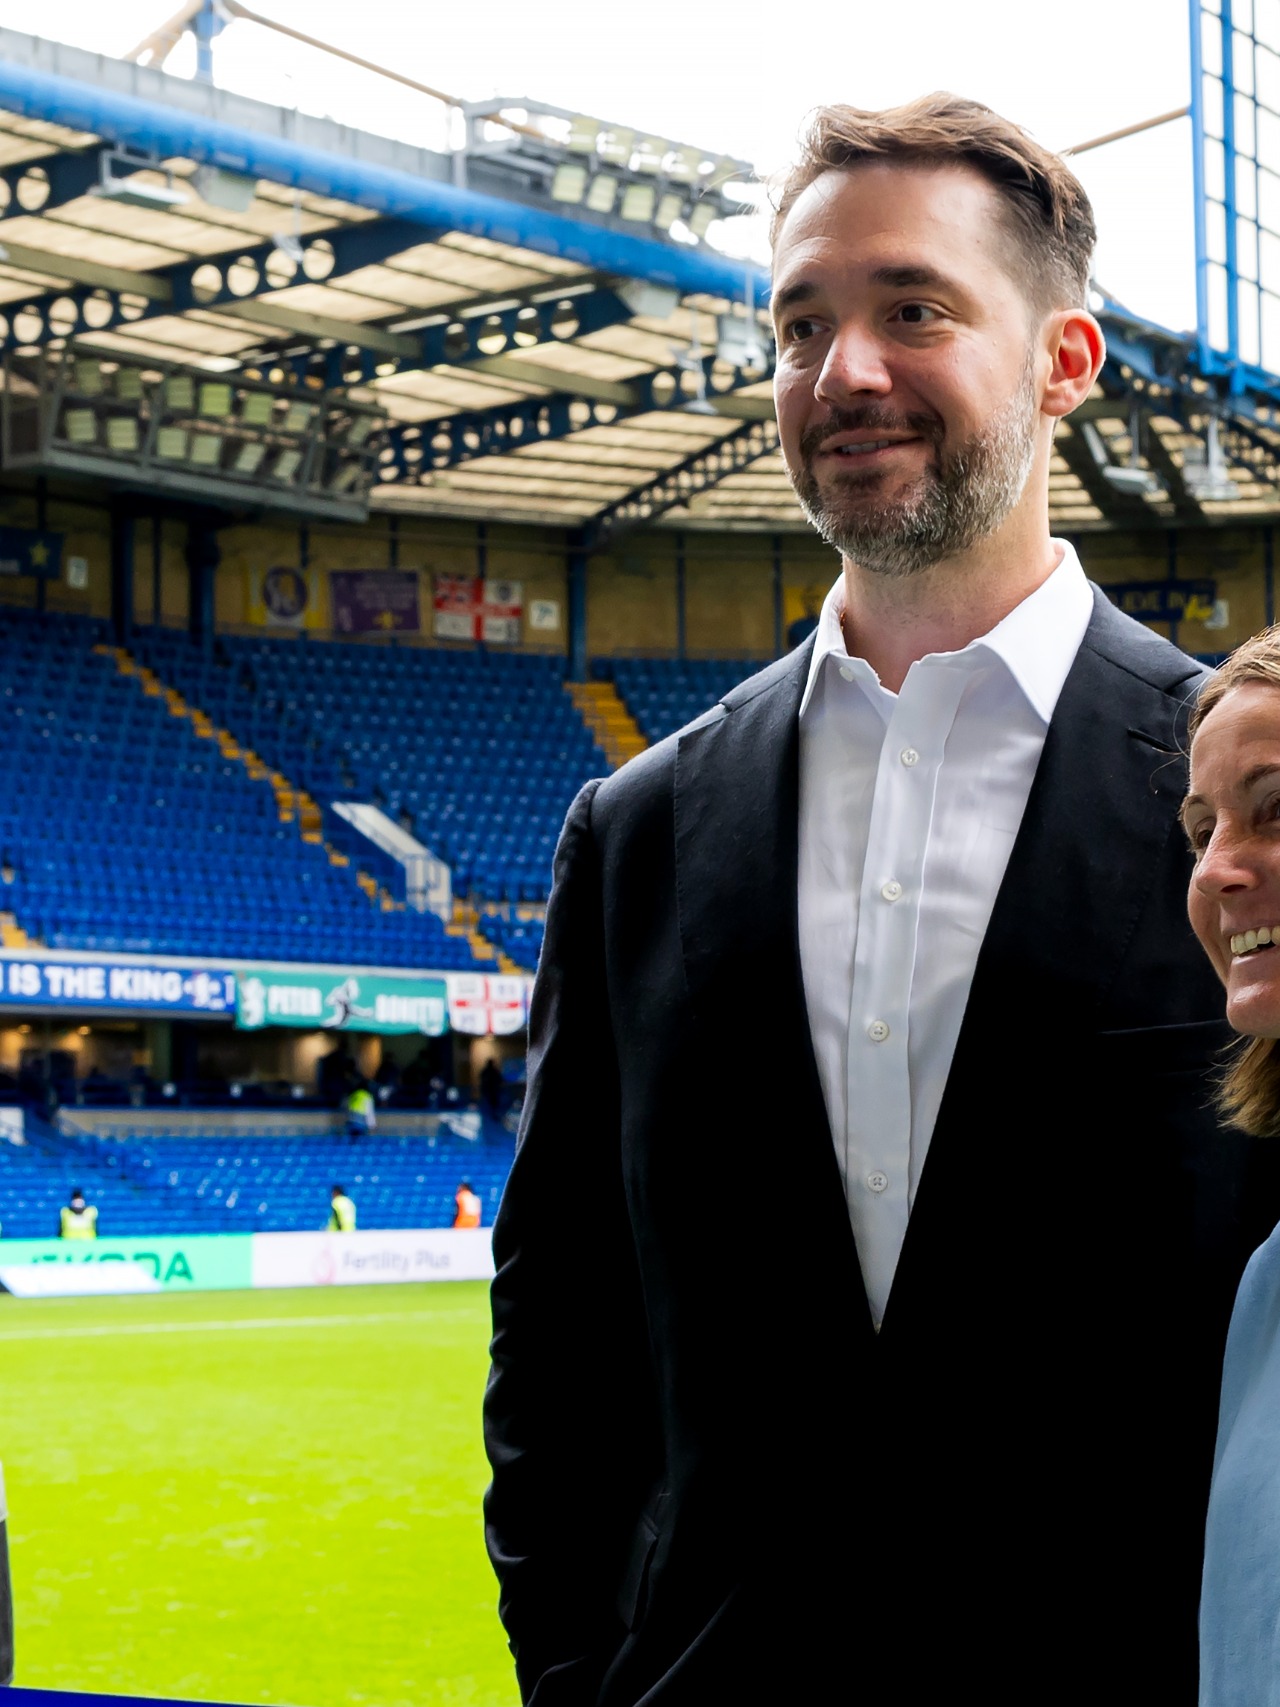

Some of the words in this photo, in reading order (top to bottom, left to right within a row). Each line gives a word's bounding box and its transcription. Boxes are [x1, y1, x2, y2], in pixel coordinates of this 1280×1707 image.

[8, 963, 41, 996] IS
[44, 966, 105, 999] THE
[109, 968, 182, 1002] KING
[343, 1250, 409, 1272] Fertility
[415, 1250, 450, 1269] Plus
